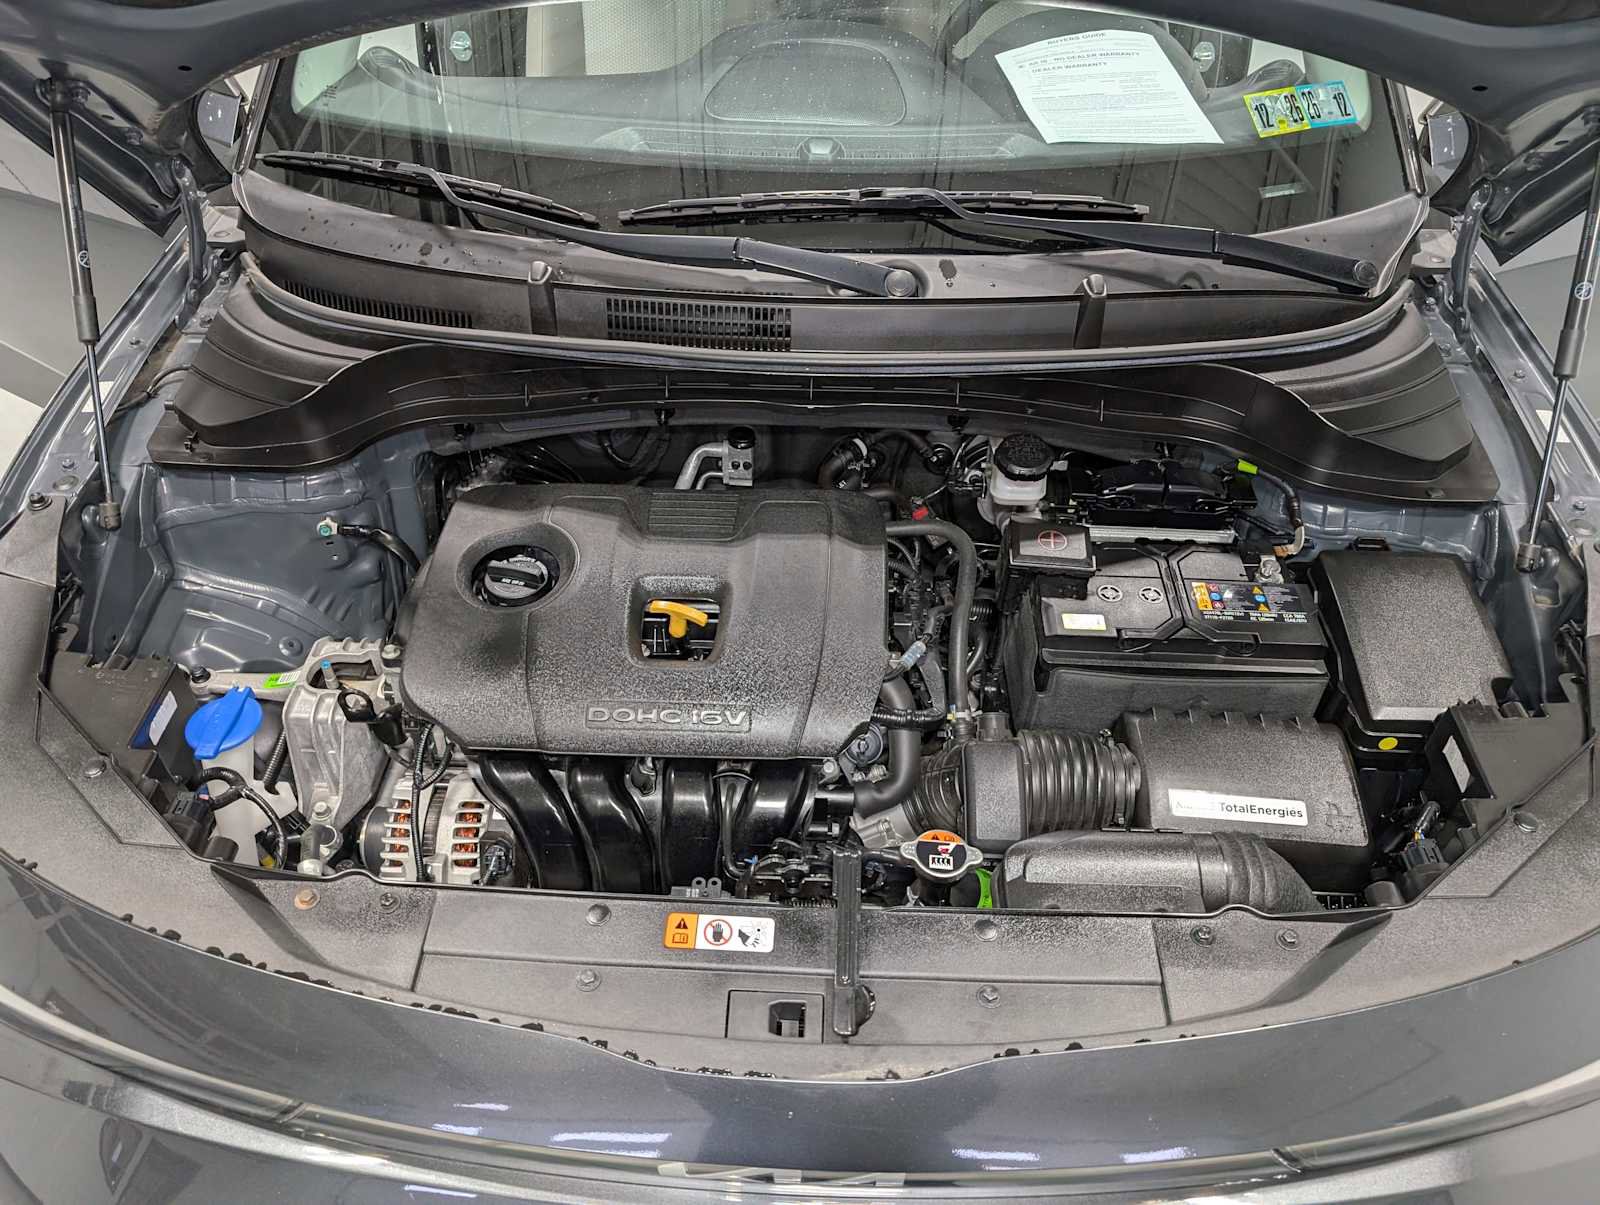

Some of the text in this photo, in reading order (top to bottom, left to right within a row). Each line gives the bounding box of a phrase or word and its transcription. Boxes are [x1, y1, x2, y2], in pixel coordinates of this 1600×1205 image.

[1047, 36, 1080, 45] BUYERS
[1032, 61, 1108, 73] DEALER WARRANTY
[1254, 94, 1305, 128] 12 26
[1301, 91, 1351, 119] 26 12
[588, 707, 747, 726] DOHC 16V
[1219, 802, 1304, 819] TotalEnergies
